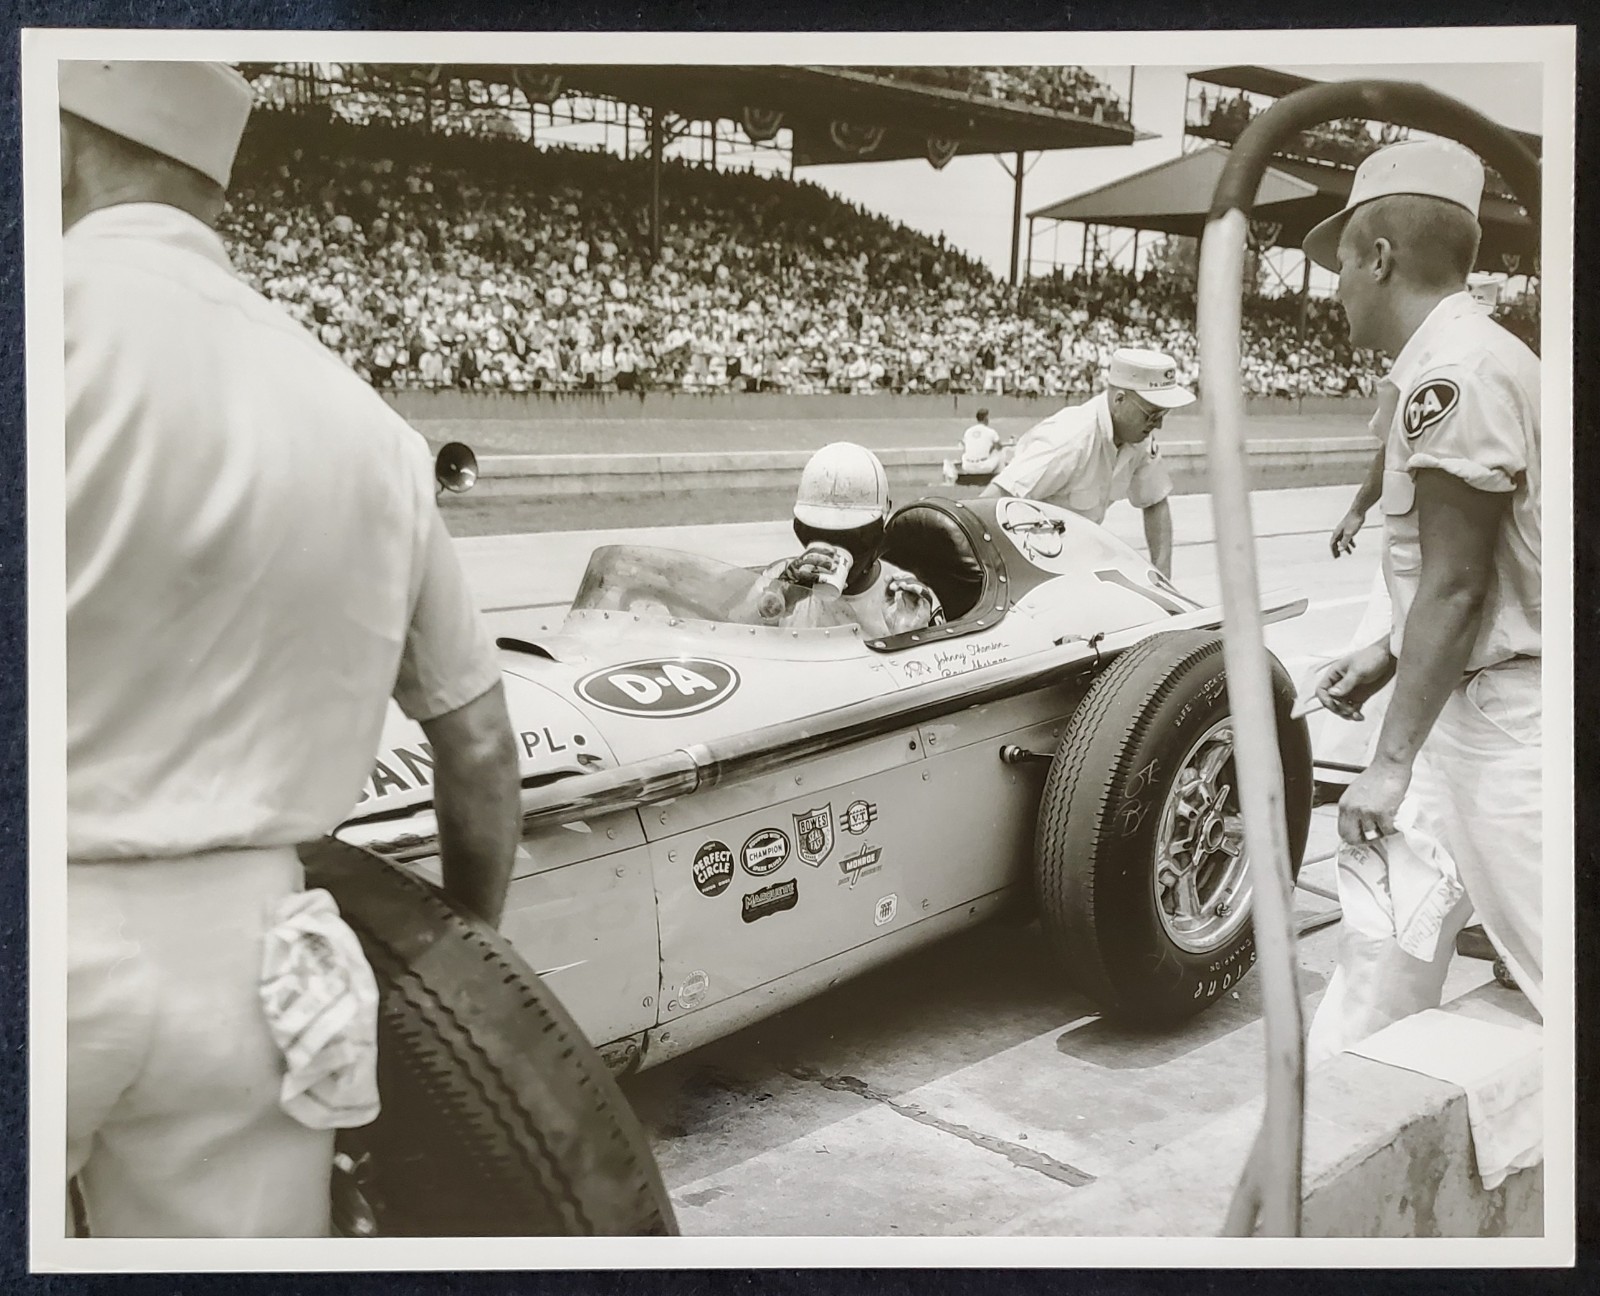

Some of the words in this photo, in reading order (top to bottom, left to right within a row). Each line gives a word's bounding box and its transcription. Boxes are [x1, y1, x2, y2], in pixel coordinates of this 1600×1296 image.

[800, 815, 827, 833] BOWES
[749, 844, 783, 861] CHAMPION
[693, 851, 732, 875] PERFECT
[846, 853, 875, 871] MONROE
[697, 863, 731, 884] CIRCLE
